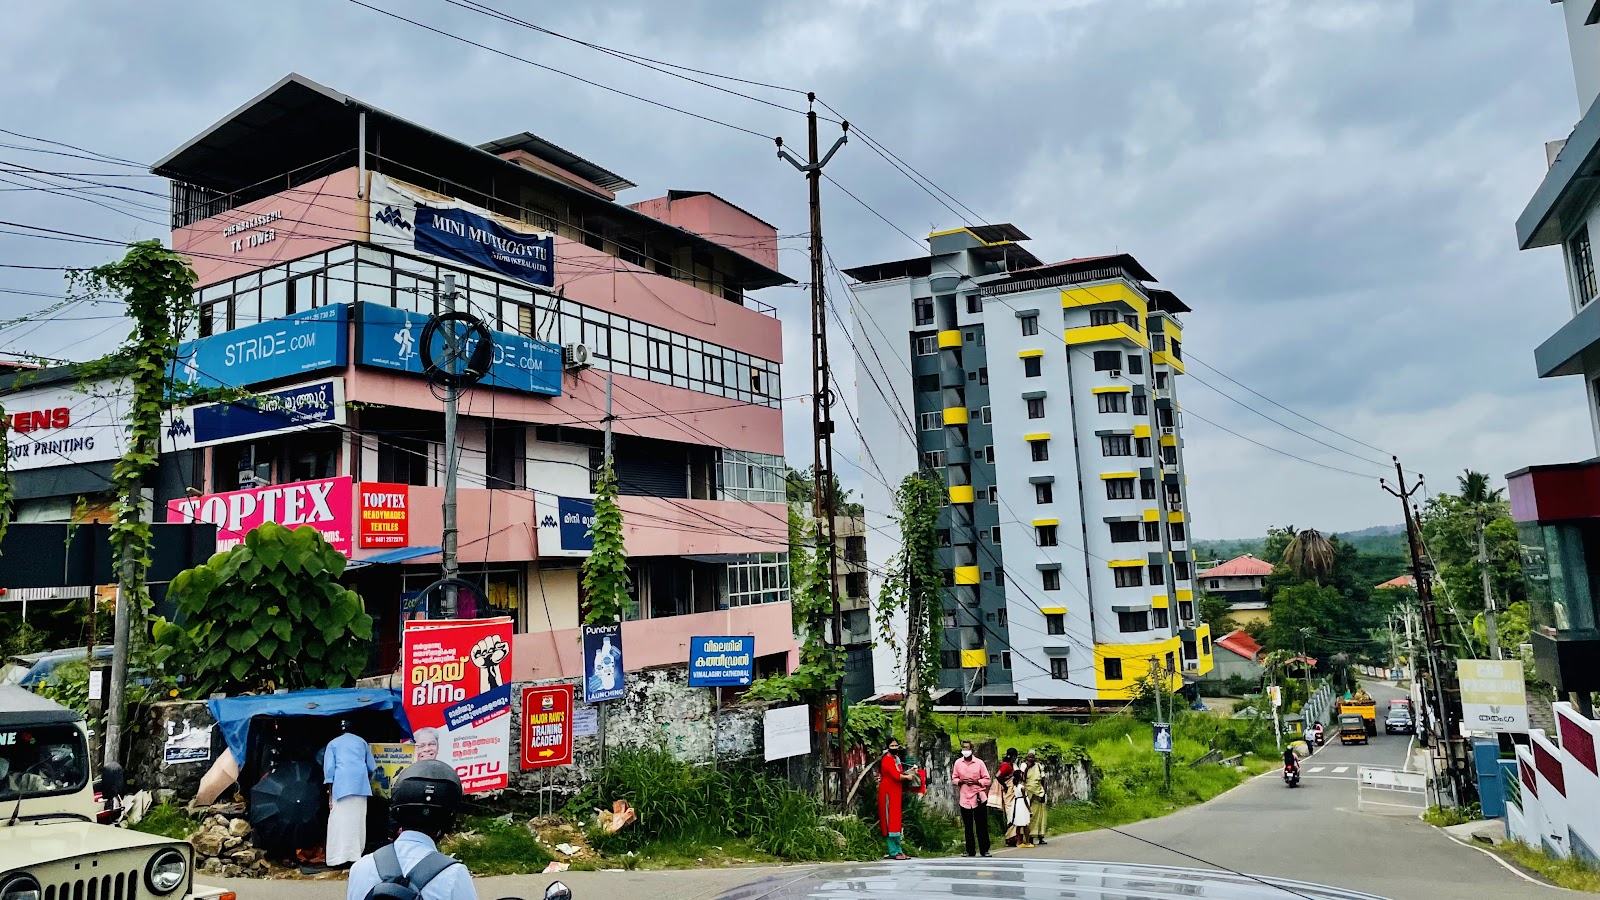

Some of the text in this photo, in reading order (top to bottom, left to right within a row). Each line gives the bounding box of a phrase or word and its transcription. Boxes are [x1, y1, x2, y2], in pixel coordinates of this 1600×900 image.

[432, 214, 465, 236] MINI
[231, 229, 275, 253] TK TOWER
[33, 436, 94, 455] PRINTING
[178, 481, 336, 533] TOPTEX
[363, 493, 405, 508] TOPTEX
[363, 510, 405, 519] READYMADES
[371, 522, 398, 531] TEXTILES
[704, 640, 742, 652] വിമലഗിരി
[412, 656, 469, 684] മെയ്
[693, 669, 750, 679] VIMALAGIRI CATHEDRAL
[412, 680, 466, 706] ദിനം
[588, 689, 624, 700] LAUNCHING
[530, 713, 548, 725] MAJOR
[549, 711, 564, 723] RAVI'S
[532, 723, 562, 737] TRAINING
[531, 734, 563, 748] ACADEMY
[455, 761, 501, 777] CITU
